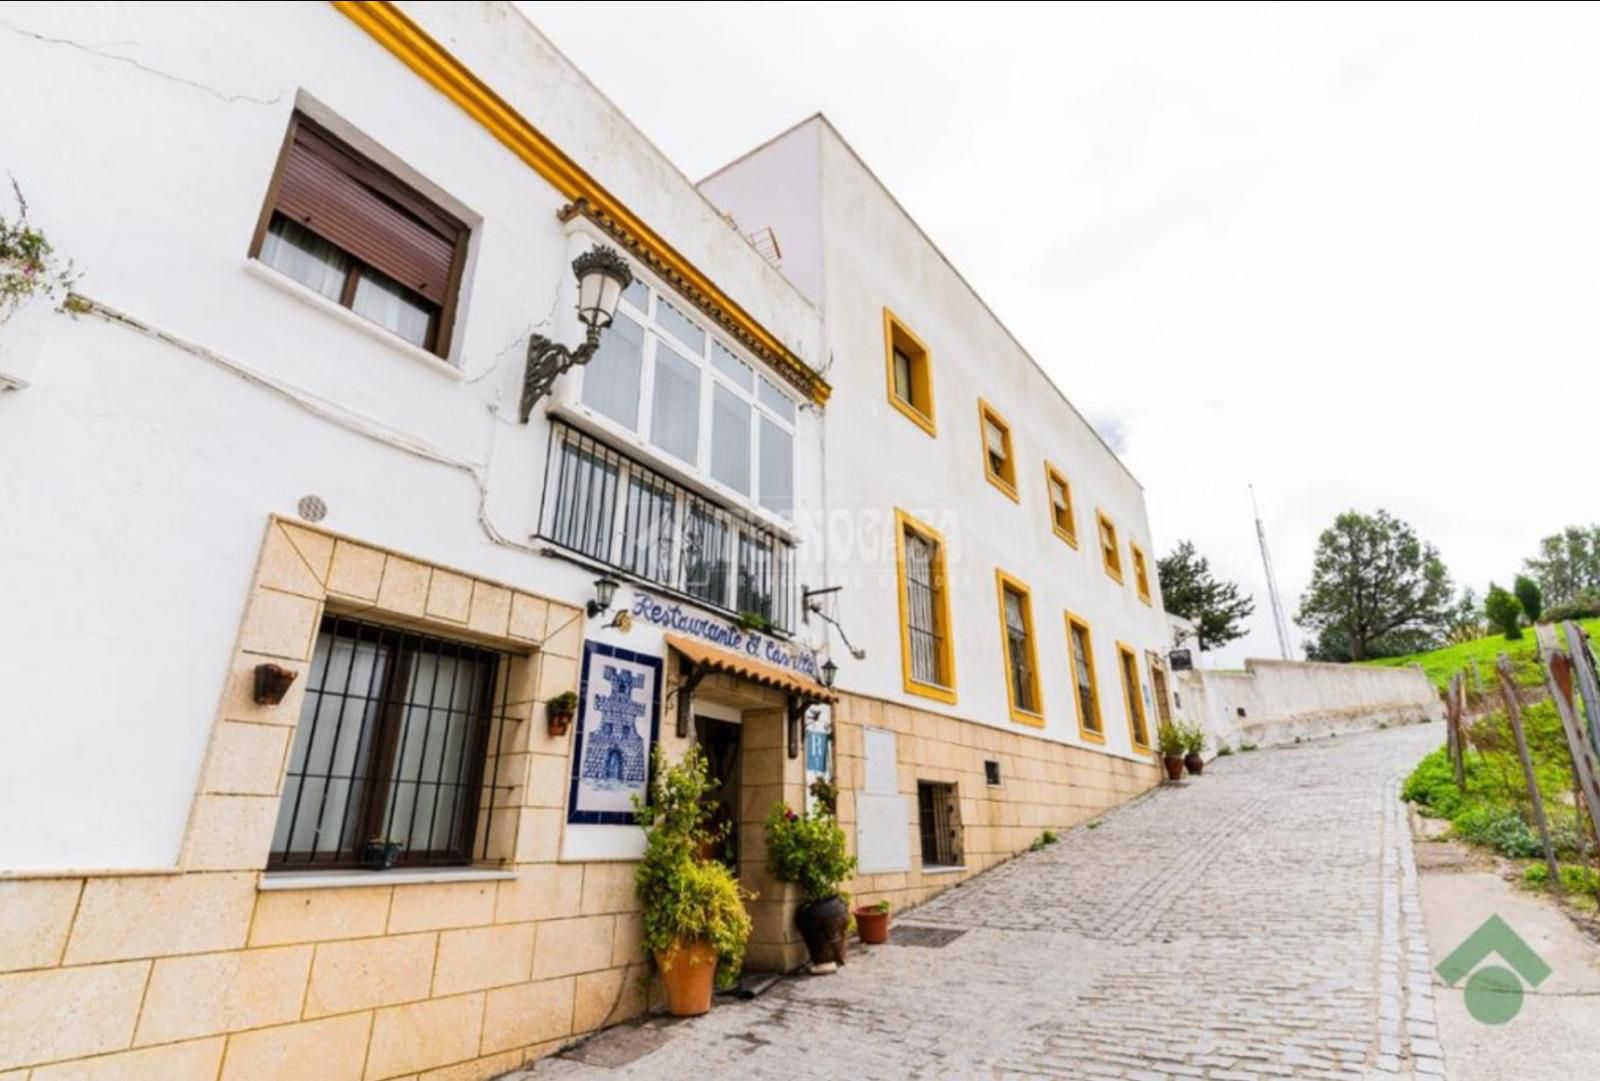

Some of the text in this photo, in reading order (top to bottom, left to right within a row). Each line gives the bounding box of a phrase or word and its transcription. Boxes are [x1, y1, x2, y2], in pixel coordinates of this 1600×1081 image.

[632, 592, 743, 649] Restaurante
[766, 640, 815, 673] Casillo
[811, 735, 823, 756] R
